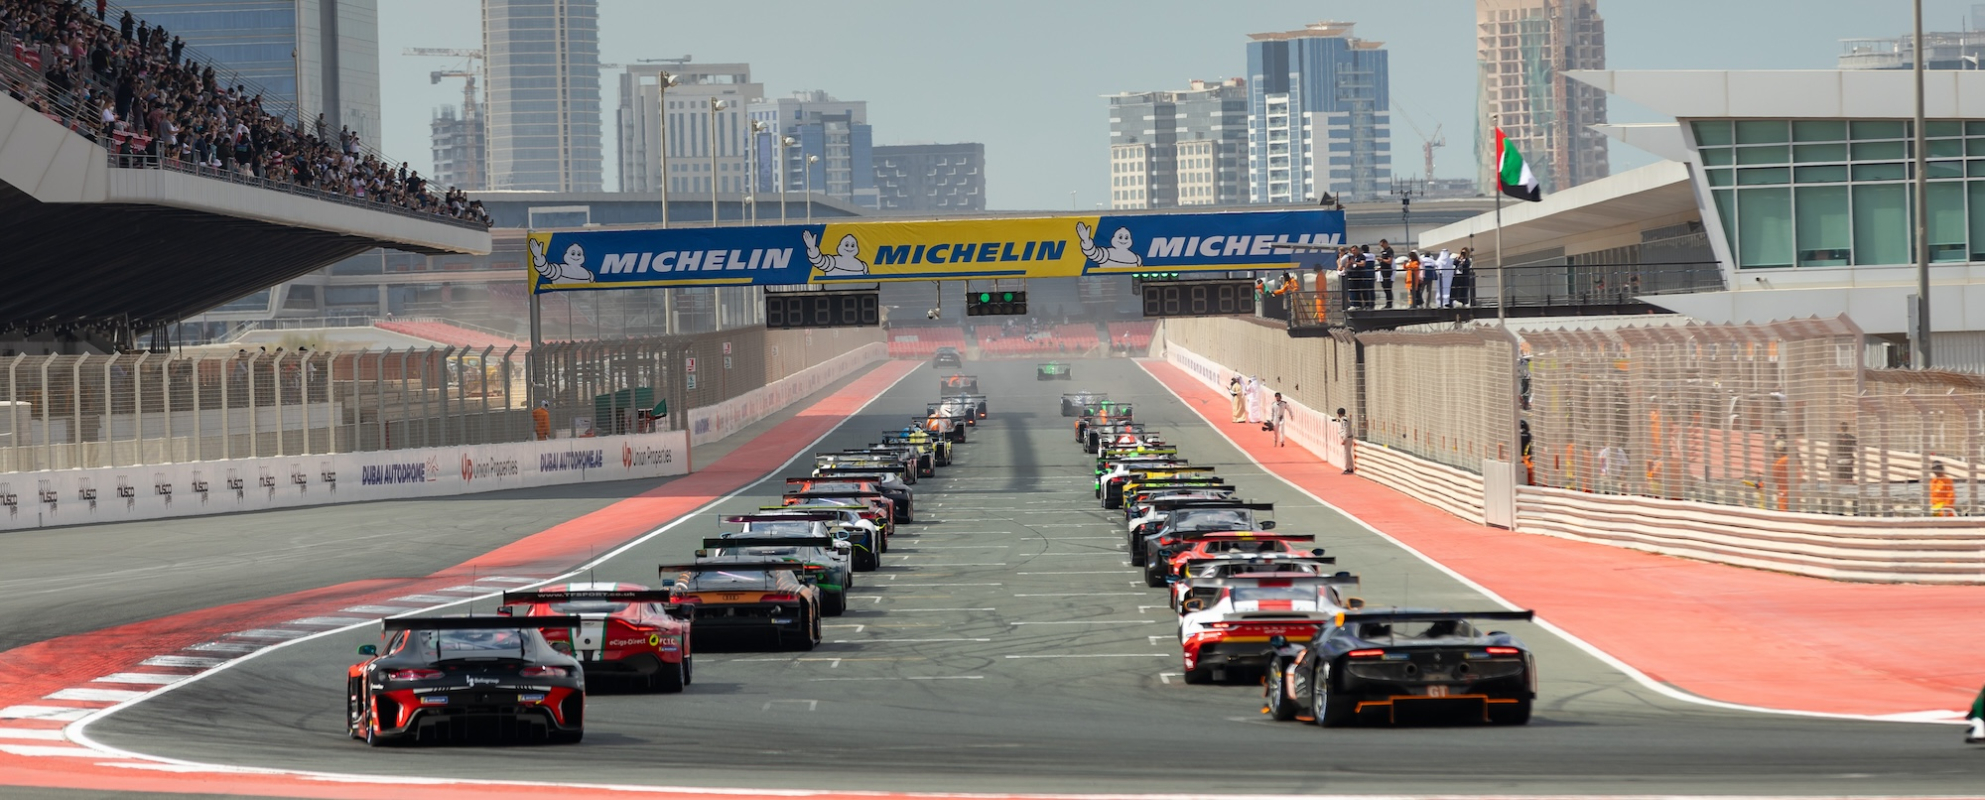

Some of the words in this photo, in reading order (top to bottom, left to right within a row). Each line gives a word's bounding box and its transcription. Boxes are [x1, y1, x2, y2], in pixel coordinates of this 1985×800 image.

[873, 240, 1067, 265] MICHELIN
[1147, 233, 1342, 258] MICHELIN
[600, 247, 794, 275] MICHELIN
[474, 458, 490, 479] Union
[491, 456, 519, 481] Properties
[540, 453, 558, 472] DUBAI
[633, 448, 646, 467] Union
[647, 445, 672, 468] Properties
[362, 464, 383, 486] DUBAI
[384, 462, 425, 485] AUTODROME
[1427, 686, 1448, 697] GT
